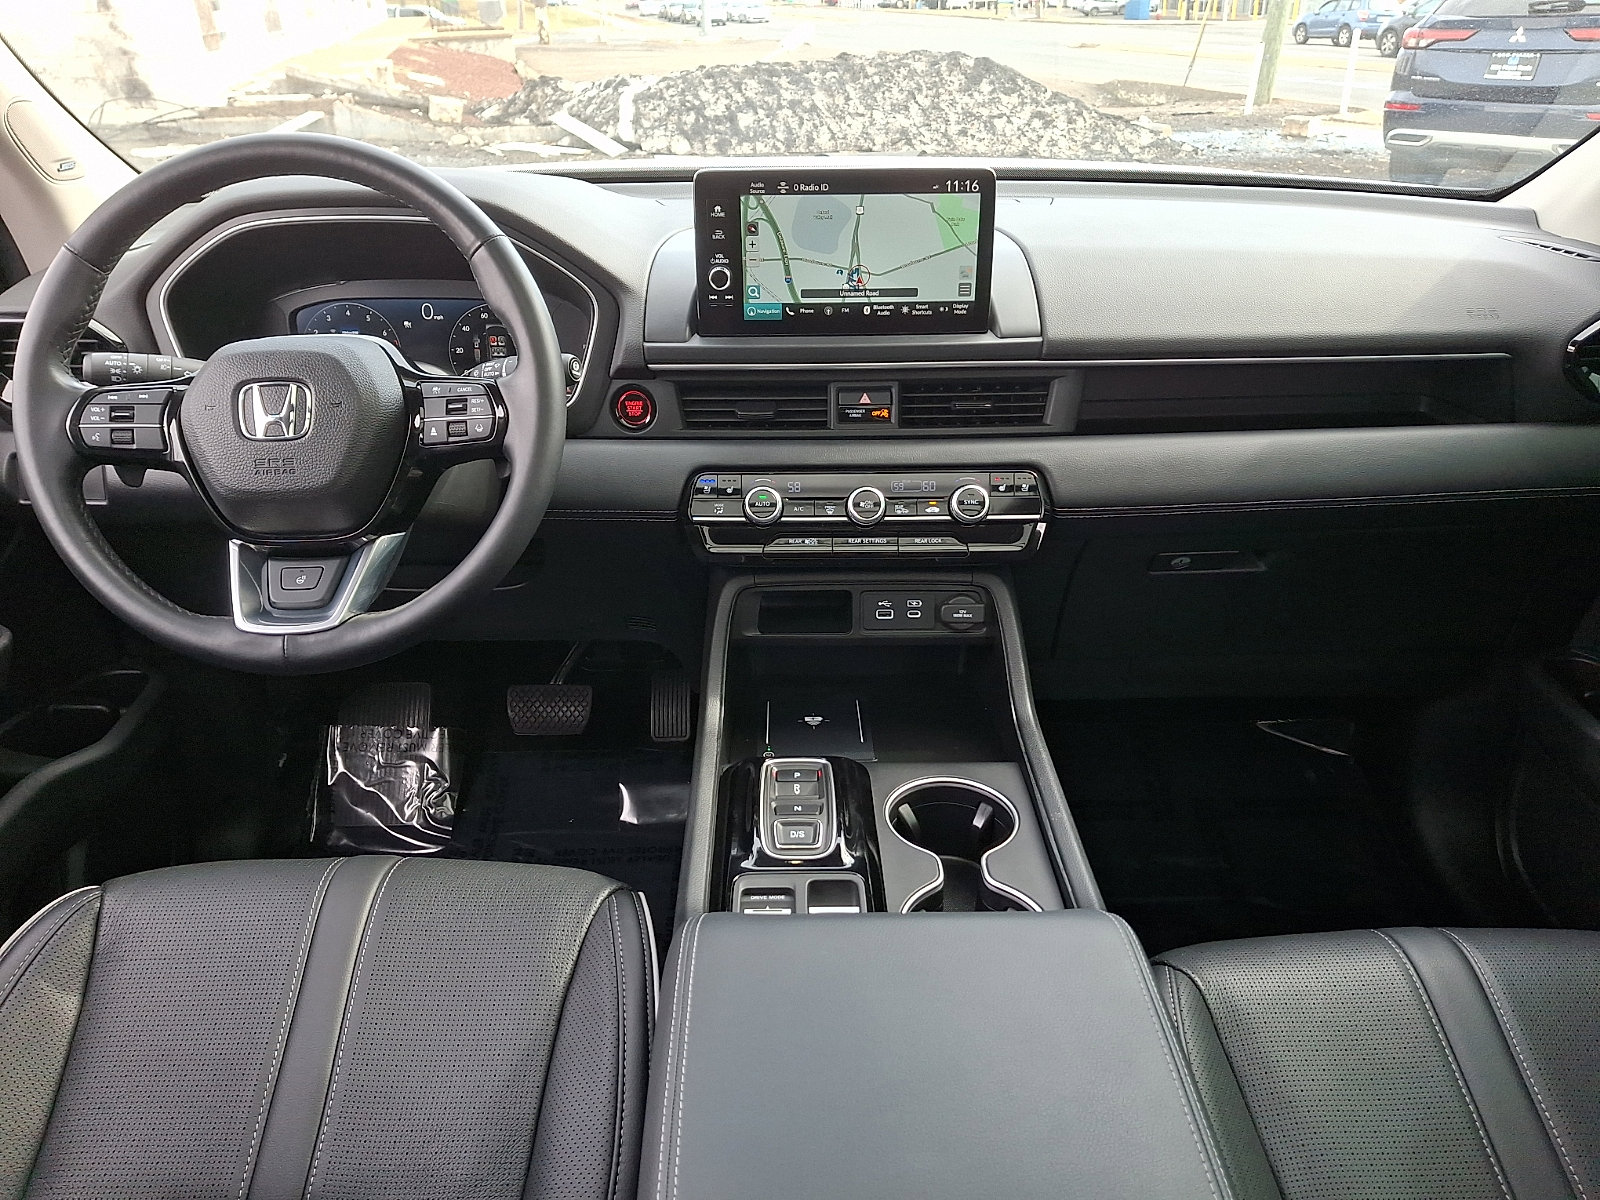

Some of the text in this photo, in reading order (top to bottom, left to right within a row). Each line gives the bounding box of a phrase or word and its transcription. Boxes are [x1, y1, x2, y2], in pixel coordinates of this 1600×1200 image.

[800, 183, 819, 191] Radio
[821, 183, 829, 191] ID
[945, 180, 980, 192] 11:16
[421, 303, 434, 320] 0
[787, 481, 801, 493] 58
[790, 830, 805, 838] D/S
